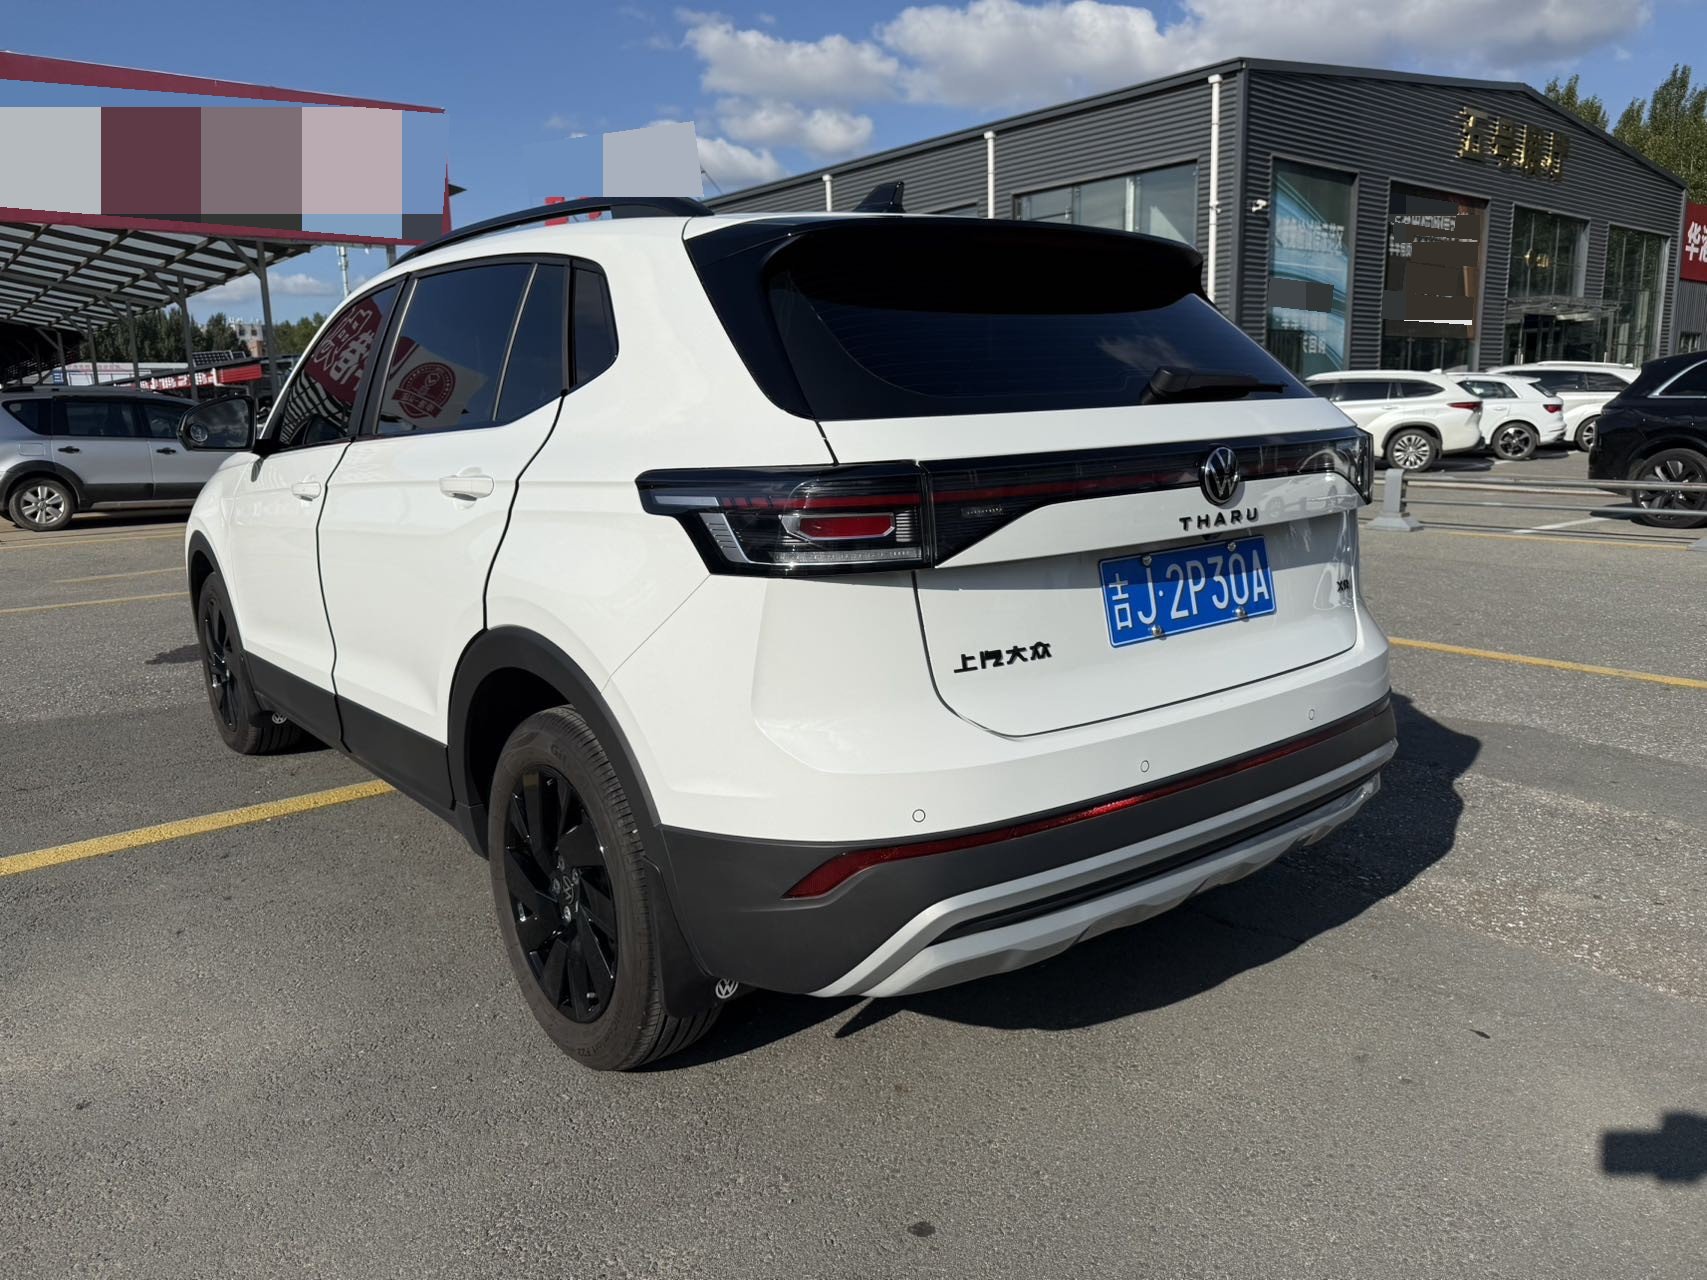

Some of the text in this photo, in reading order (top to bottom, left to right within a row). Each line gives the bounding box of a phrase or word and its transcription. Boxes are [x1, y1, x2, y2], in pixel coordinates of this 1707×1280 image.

[1179, 507, 1258, 531] THARU
[953, 641, 1053, 673] 上汽大众
